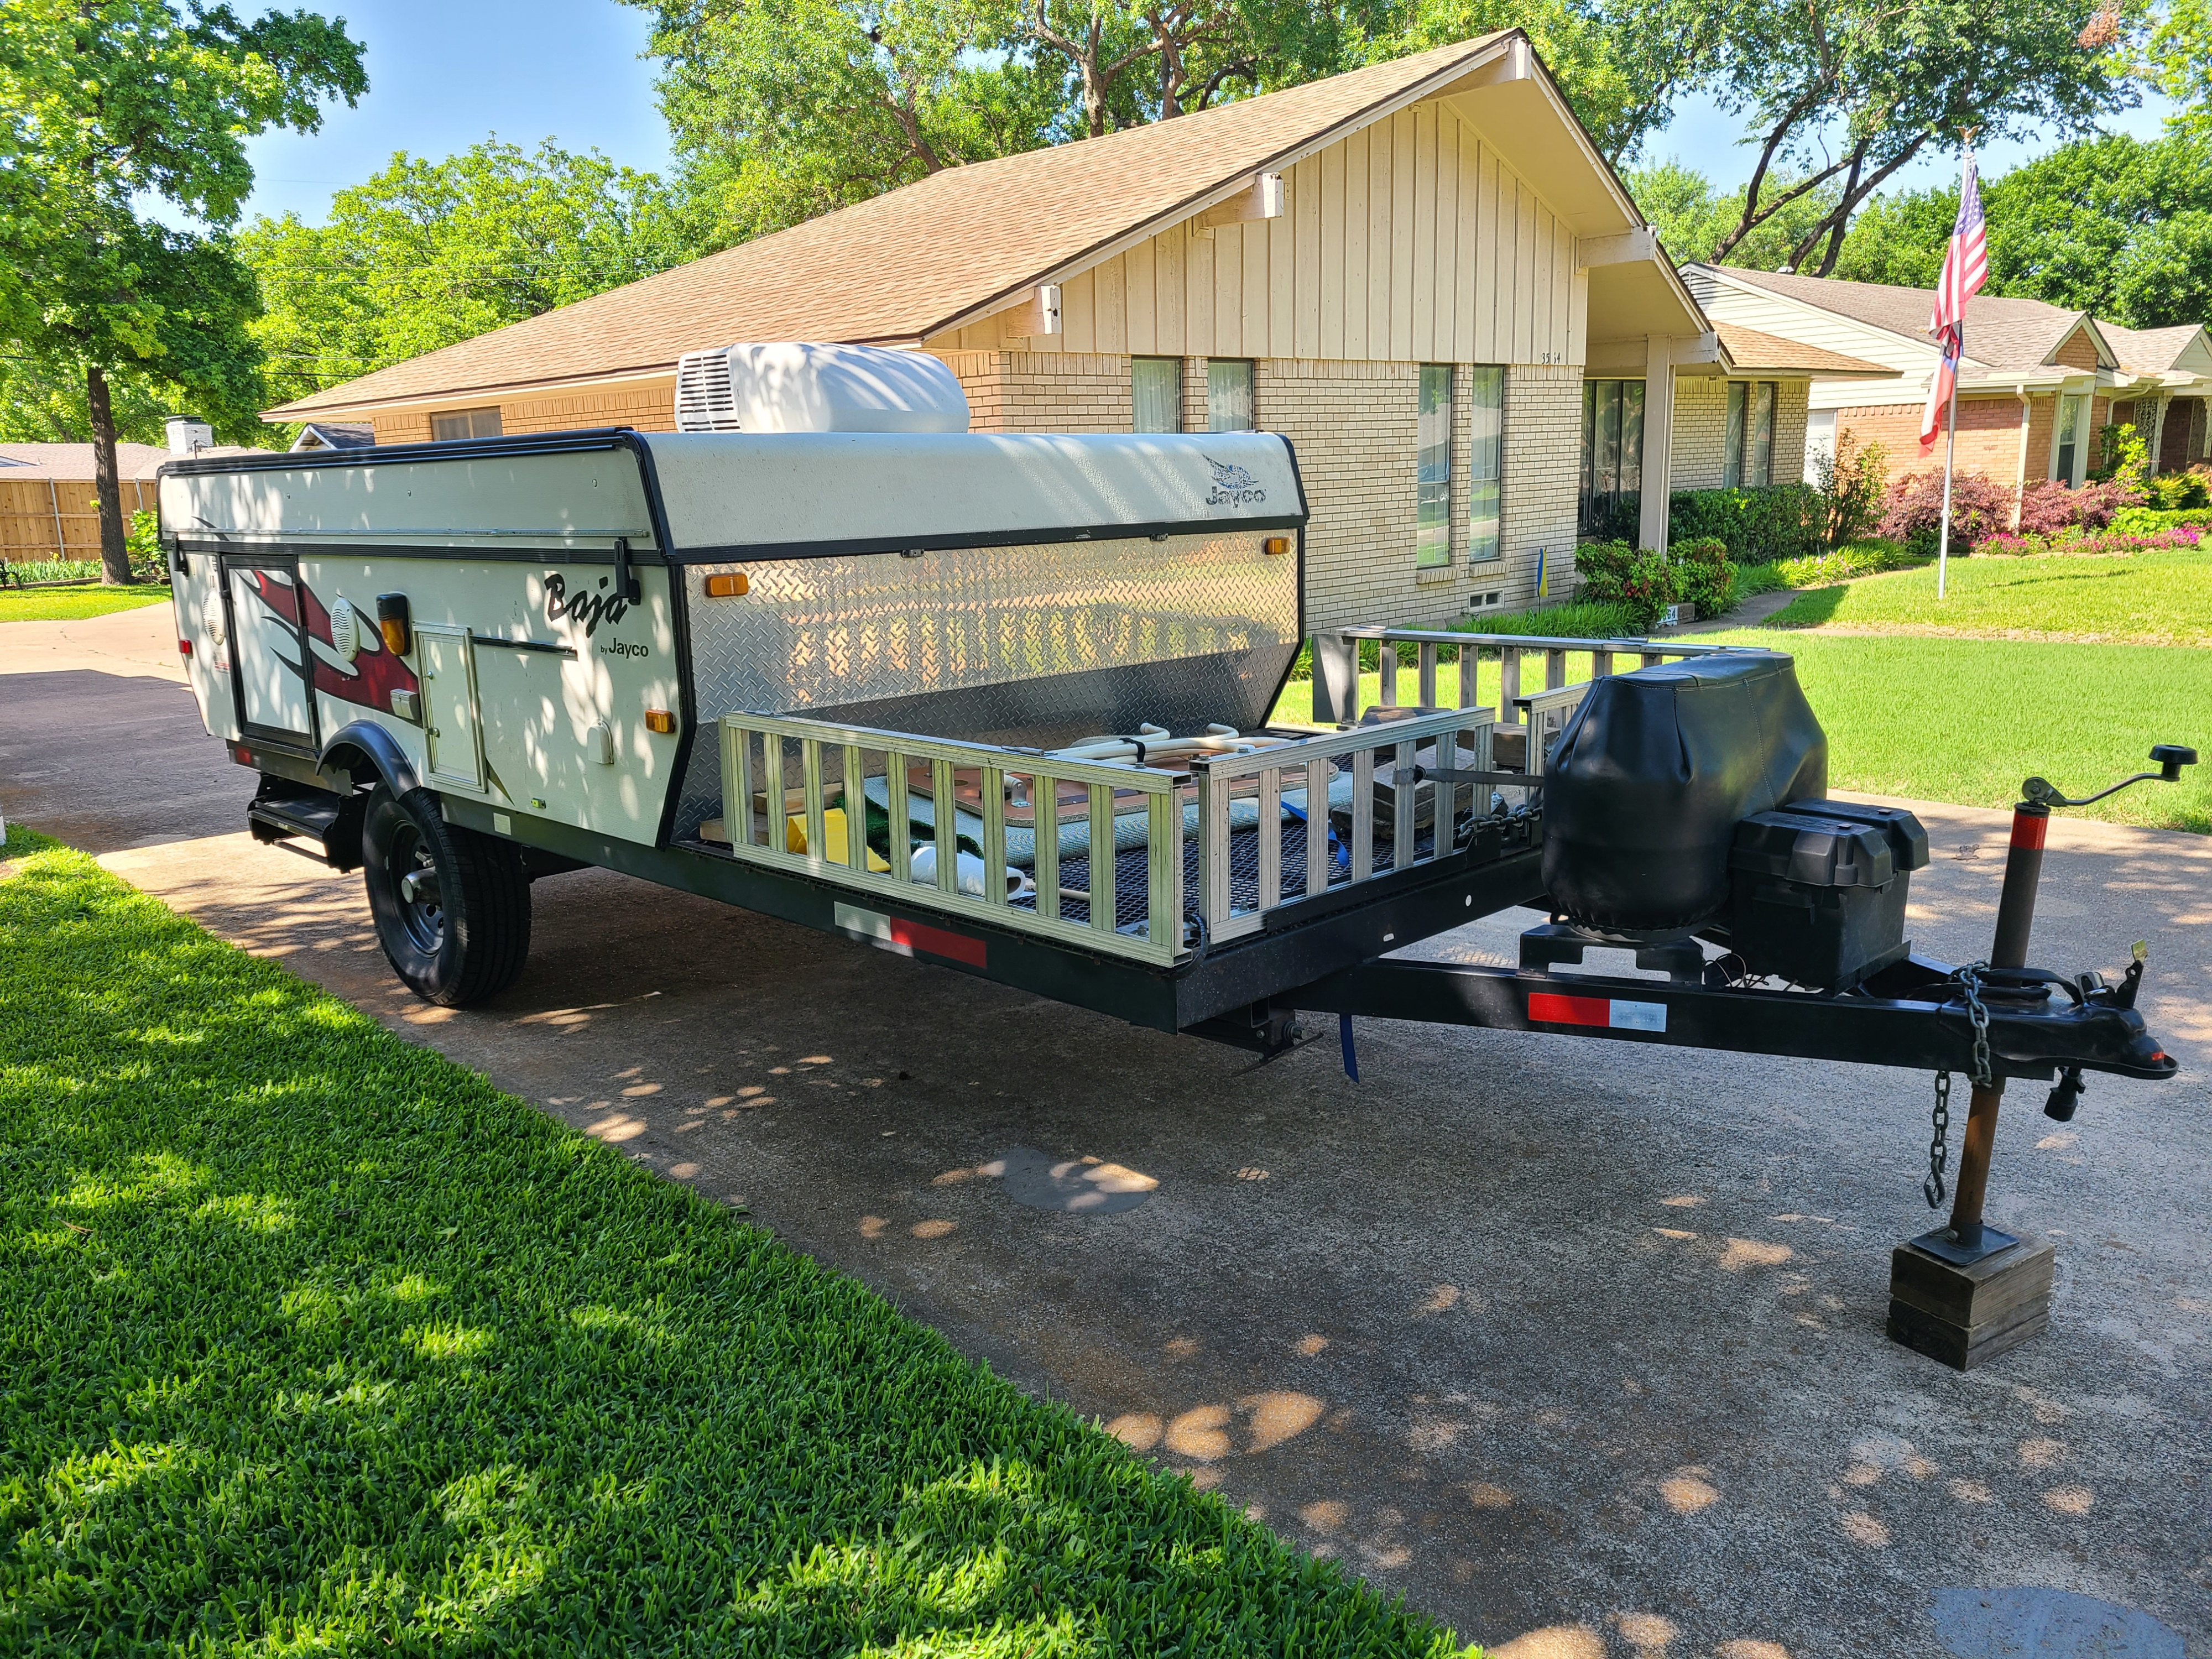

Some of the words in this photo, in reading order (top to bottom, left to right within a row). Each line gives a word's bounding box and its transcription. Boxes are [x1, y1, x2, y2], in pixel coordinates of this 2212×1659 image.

[1206, 486, 1266, 508] Jayco
[544, 573, 628, 638] Baja
[601, 645, 608, 655] by
[609, 638, 649, 659] Jayco
